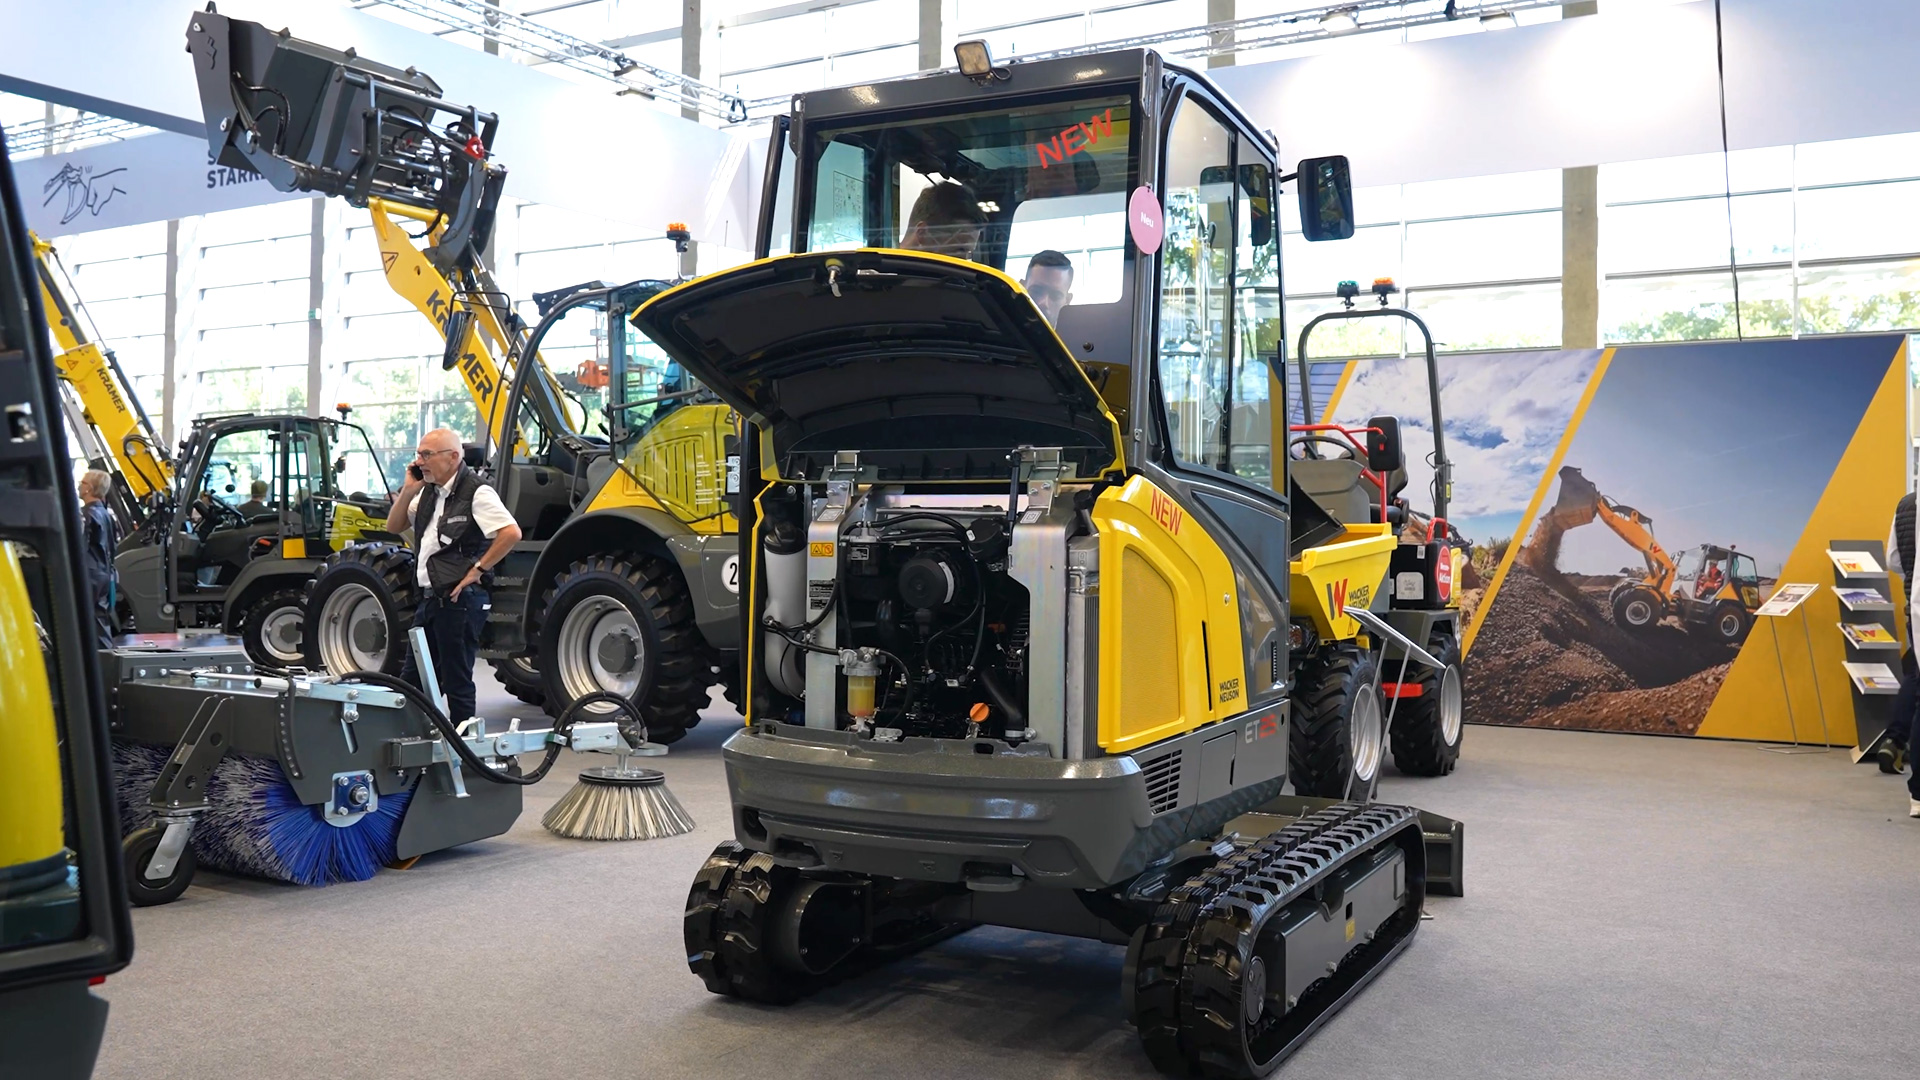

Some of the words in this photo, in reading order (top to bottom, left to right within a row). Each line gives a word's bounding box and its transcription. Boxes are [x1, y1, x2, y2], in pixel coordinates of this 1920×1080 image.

[1036, 108, 1112, 169] NEW
[1140, 211, 1154, 228] Neu
[426, 288, 493, 404] KRMER
[97, 367, 126, 413] KRAMER
[1150, 488, 1182, 536] NEW
[1348, 585, 1369, 602] WACKER
[1219, 678, 1239, 692] WACKER
[1219, 689, 1239, 703] NEUSON
